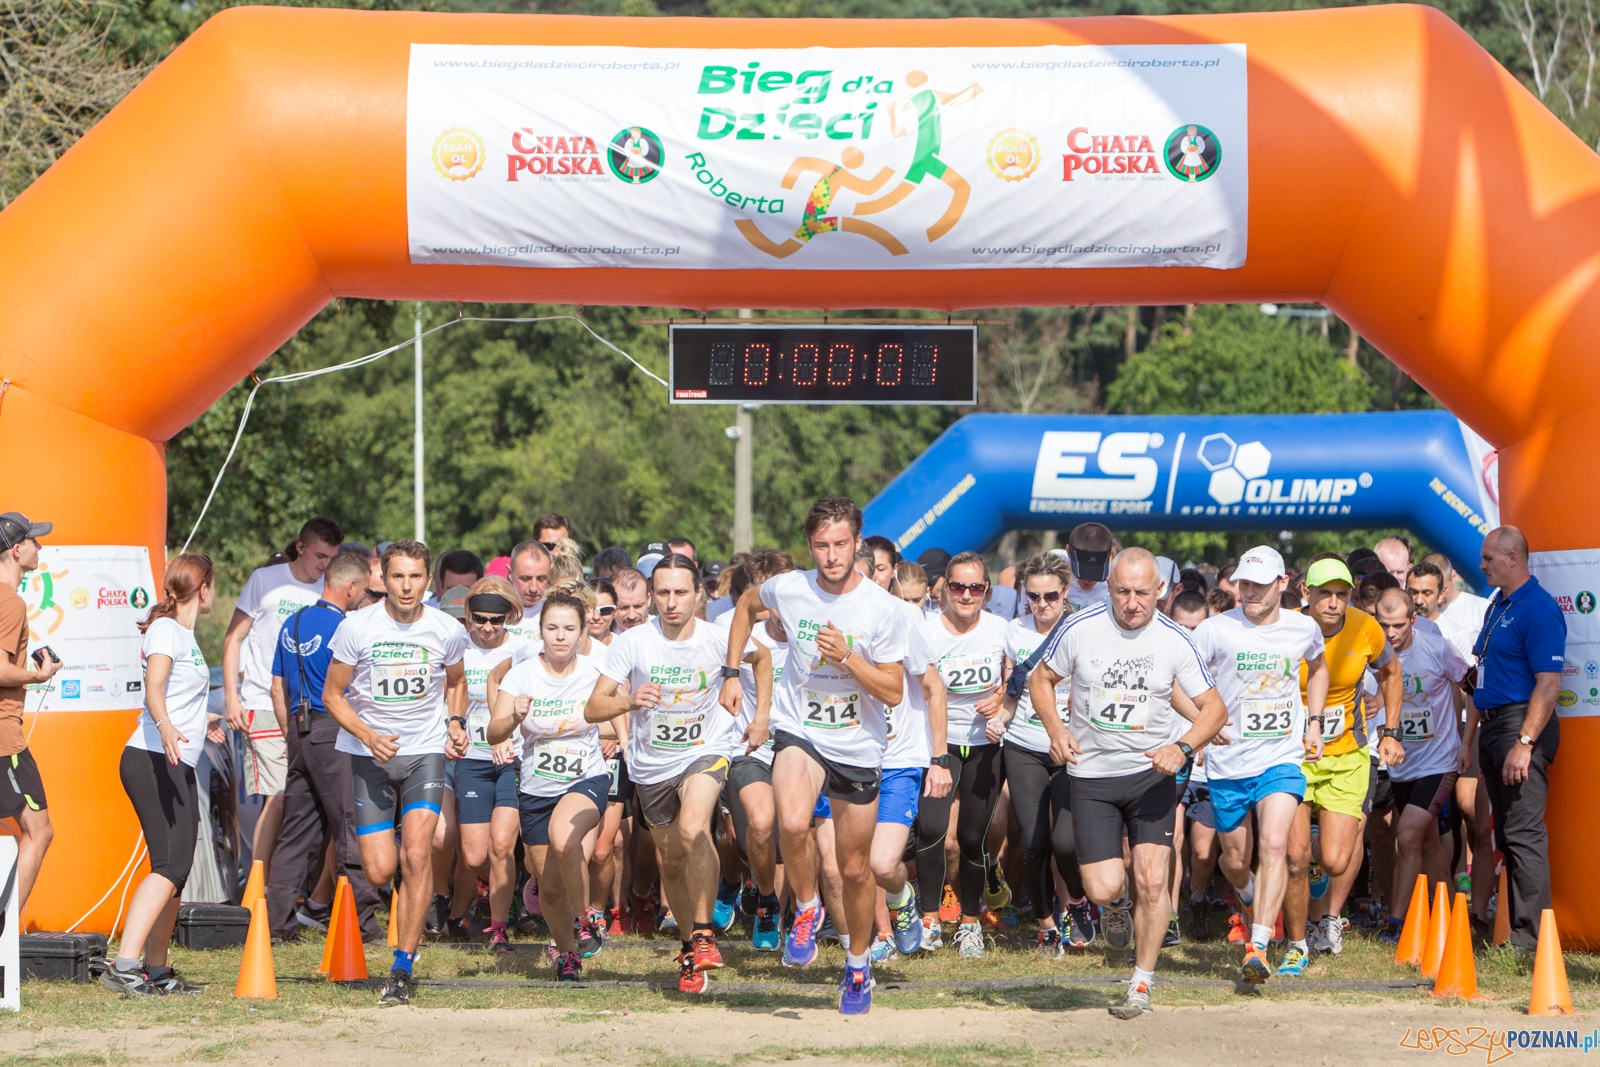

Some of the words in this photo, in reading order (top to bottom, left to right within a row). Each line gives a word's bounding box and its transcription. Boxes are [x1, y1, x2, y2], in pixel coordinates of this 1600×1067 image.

[433, 59, 681, 71] www.biegdladzieciroberta.pl
[971, 57, 1220, 70] www.biegdladzieciroberta.pl
[697, 61, 833, 104] Bieg
[841, 75, 894, 94] dla
[697, 102, 878, 140] Dzieci
[443, 143, 473, 152] MAR
[1061, 153, 1161, 181] POLSKA
[685, 152, 784, 214] Roberta
[433, 246, 681, 256] www.biegdladzieciroberta.pl
[972, 243, 1221, 255] www.biegdladzieciroberta.pl
[1029, 499, 1107, 514] ENDURANCE
[1109, 500, 1153, 515] SPORT
[1181, 505, 1240, 516] SPORT
[1249, 504, 1352, 516] NUTRITION
[371, 650, 415, 659] Dzieci
[1236, 651, 1267, 662] Bieg
[650, 665, 681, 676] Bieg
[1237, 661, 1278, 671] Dzieci
[650, 674, 692, 685] Dzieci
[948, 666, 992, 687] 220
[377, 677, 426, 696] 103
[533, 698, 563, 708] Bieg
[532, 705, 574, 718] Dzieci
[807, 702, 857, 723] 214
[1100, 703, 1135, 723] 47
[1247, 710, 1291, 731] 323
[656, 723, 702, 742] 320
[537, 752, 583, 776] 284
